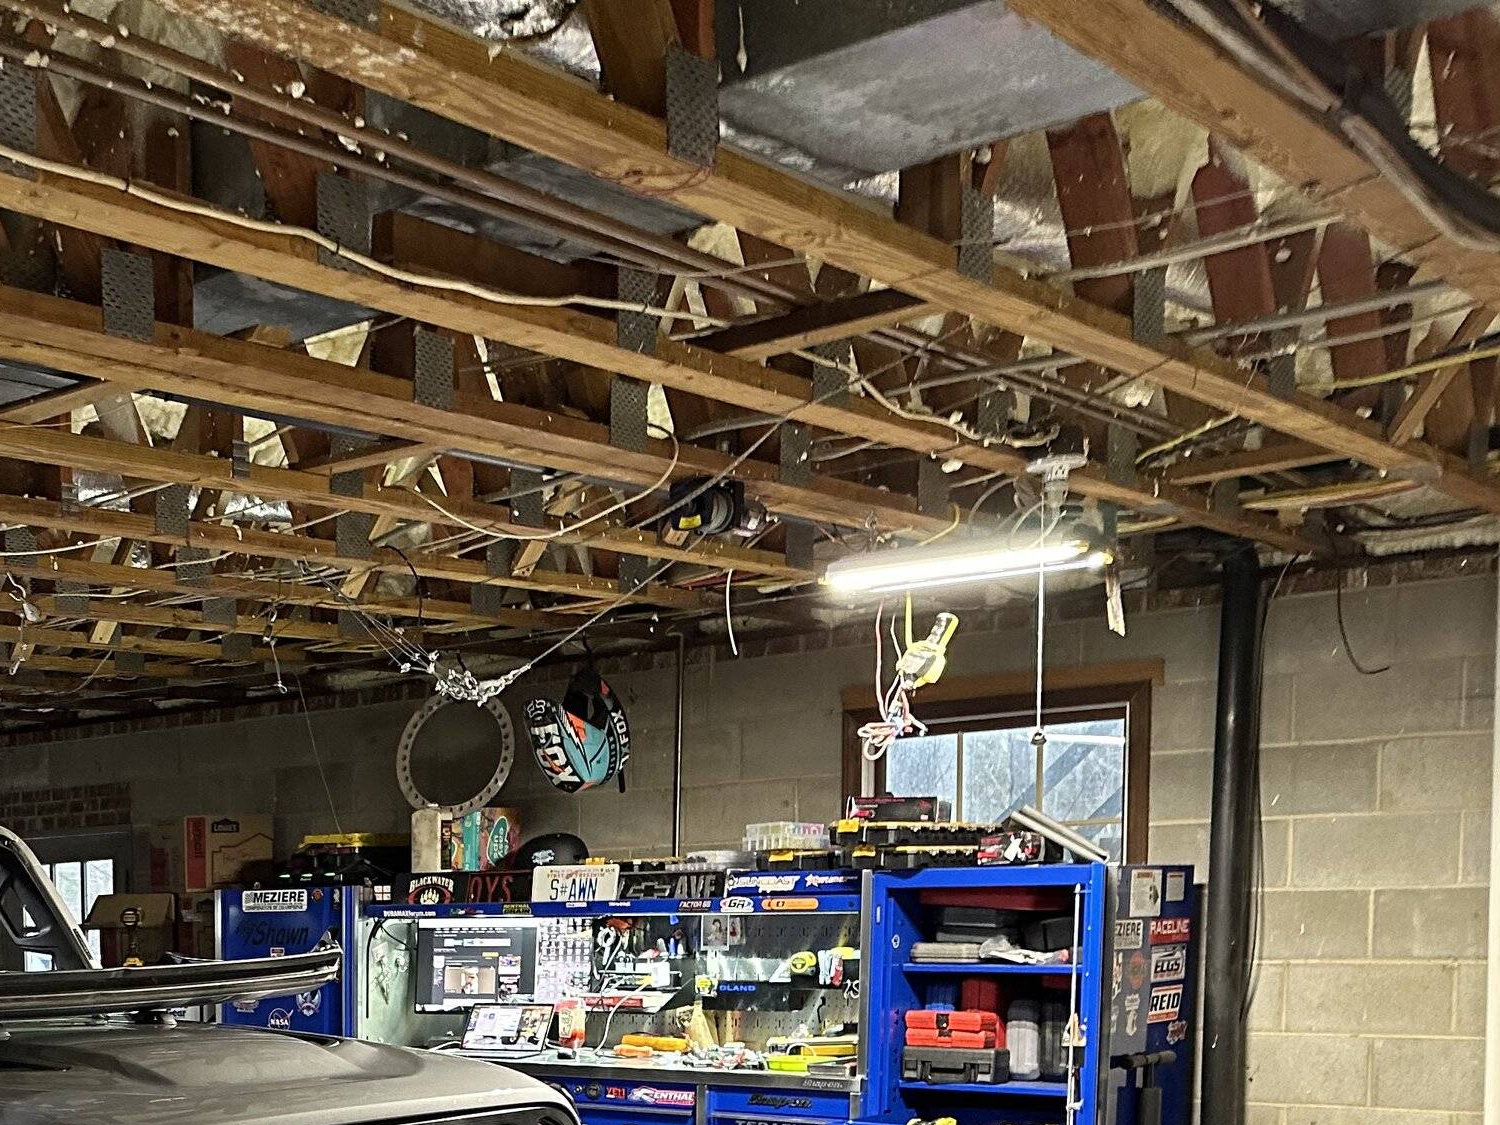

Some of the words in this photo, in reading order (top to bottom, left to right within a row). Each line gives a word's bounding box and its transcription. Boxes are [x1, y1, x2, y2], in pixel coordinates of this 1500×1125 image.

[529, 722, 582, 786] FOX
[409, 876, 455, 893] BLACKWATER
[253, 890, 305, 904] MEZIERE
[1150, 918, 1191, 935] RACELINE
[1151, 991, 1181, 1012] REID
[270, 1018, 289, 1026] NASA
